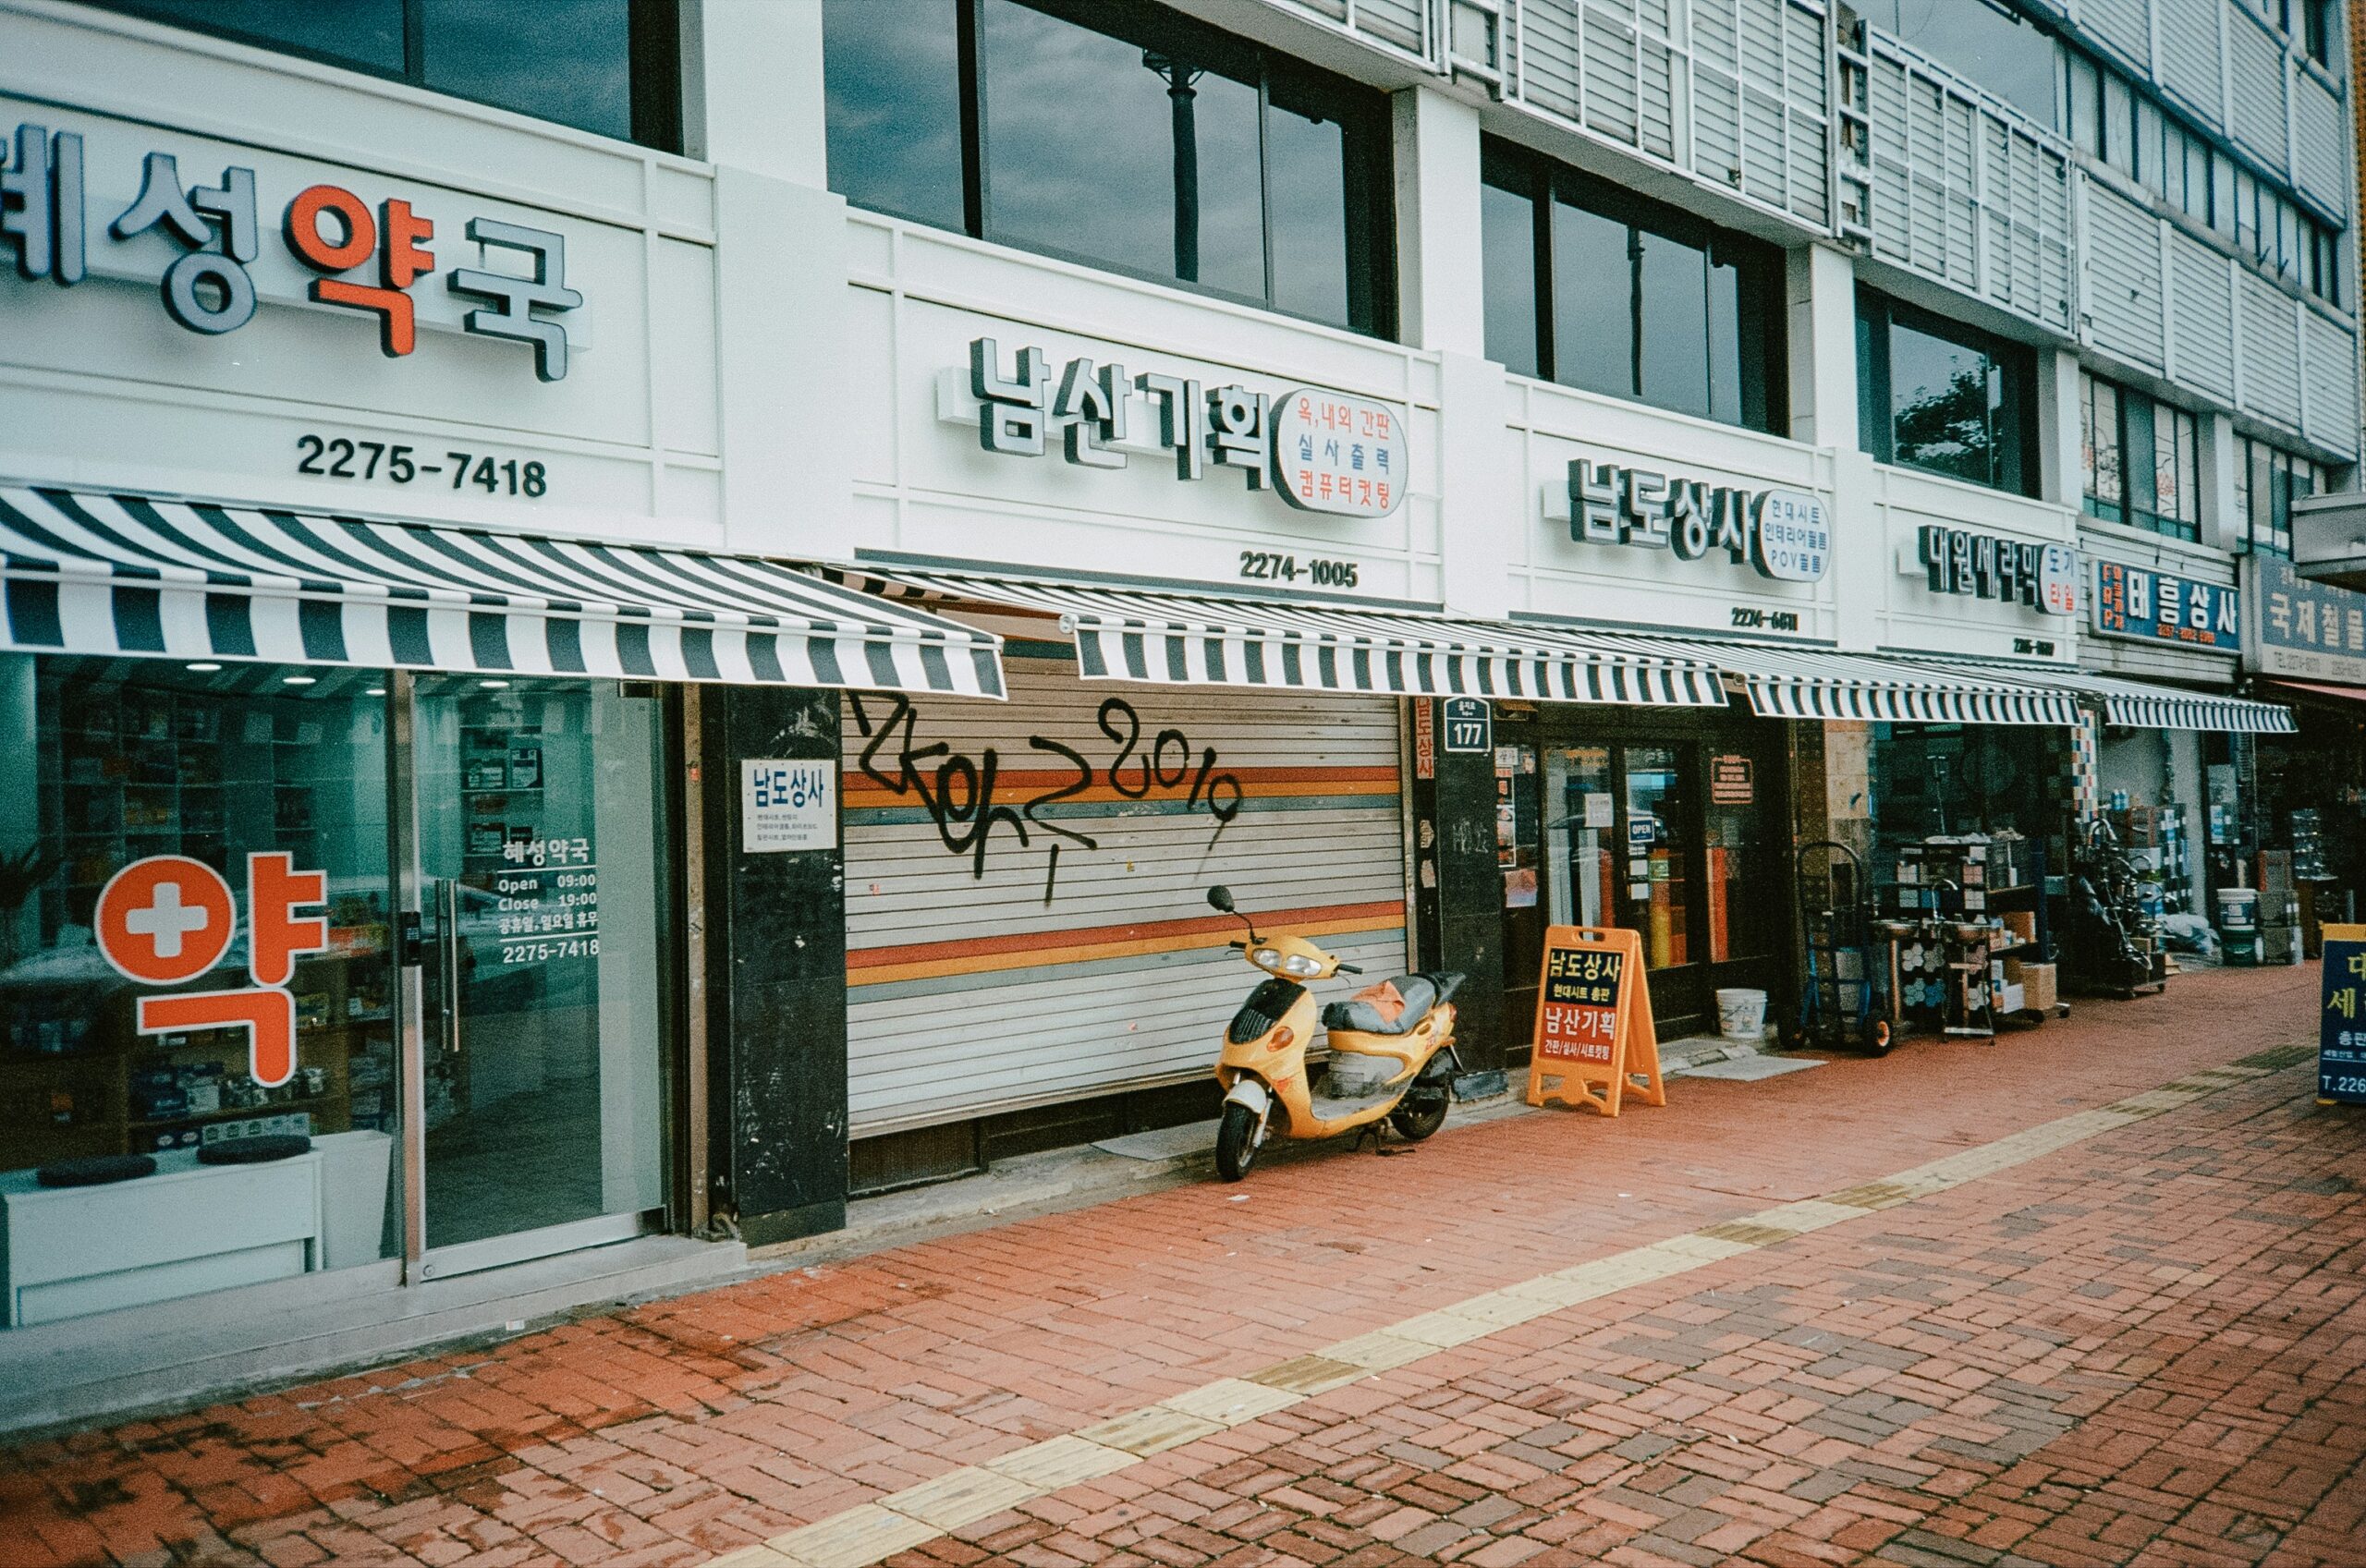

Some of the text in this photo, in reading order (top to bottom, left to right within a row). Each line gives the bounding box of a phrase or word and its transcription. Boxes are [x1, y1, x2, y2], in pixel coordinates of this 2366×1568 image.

[970, 337, 1272, 492] 남산기획
[1298, 397, 1390, 441] 옥,내외 간판
[297, 433, 548, 498] 2275-7418
[1299, 469, 1390, 509] 컴퓨터컷팅
[1567, 458, 1755, 565] 남도상사
[1239, 550, 1359, 589] 2274-1005
[2127, 570, 2237, 635] 태흥상사
[2269, 592, 2365, 651] 국제철물
[1416, 697, 1433, 778] 남도상사
[1454, 723, 1482, 745] 177
[753, 768, 823, 808] 남도상사
[1632, 824, 1651, 835] OPEN
[502, 838, 590, 867] 혜성약국
[498, 874, 596, 894] Open 09:00
[498, 893, 597, 911] Close 19:00
[577, 911, 599, 928] 휴무
[94, 851, 328, 1088] 약
[503, 939, 600, 964] 2275-7418
[1550, 951, 1620, 982] 남도상사
[1554, 983, 1610, 1002] 현대시트 총판
[1545, 1007, 1616, 1040] 남산기획
